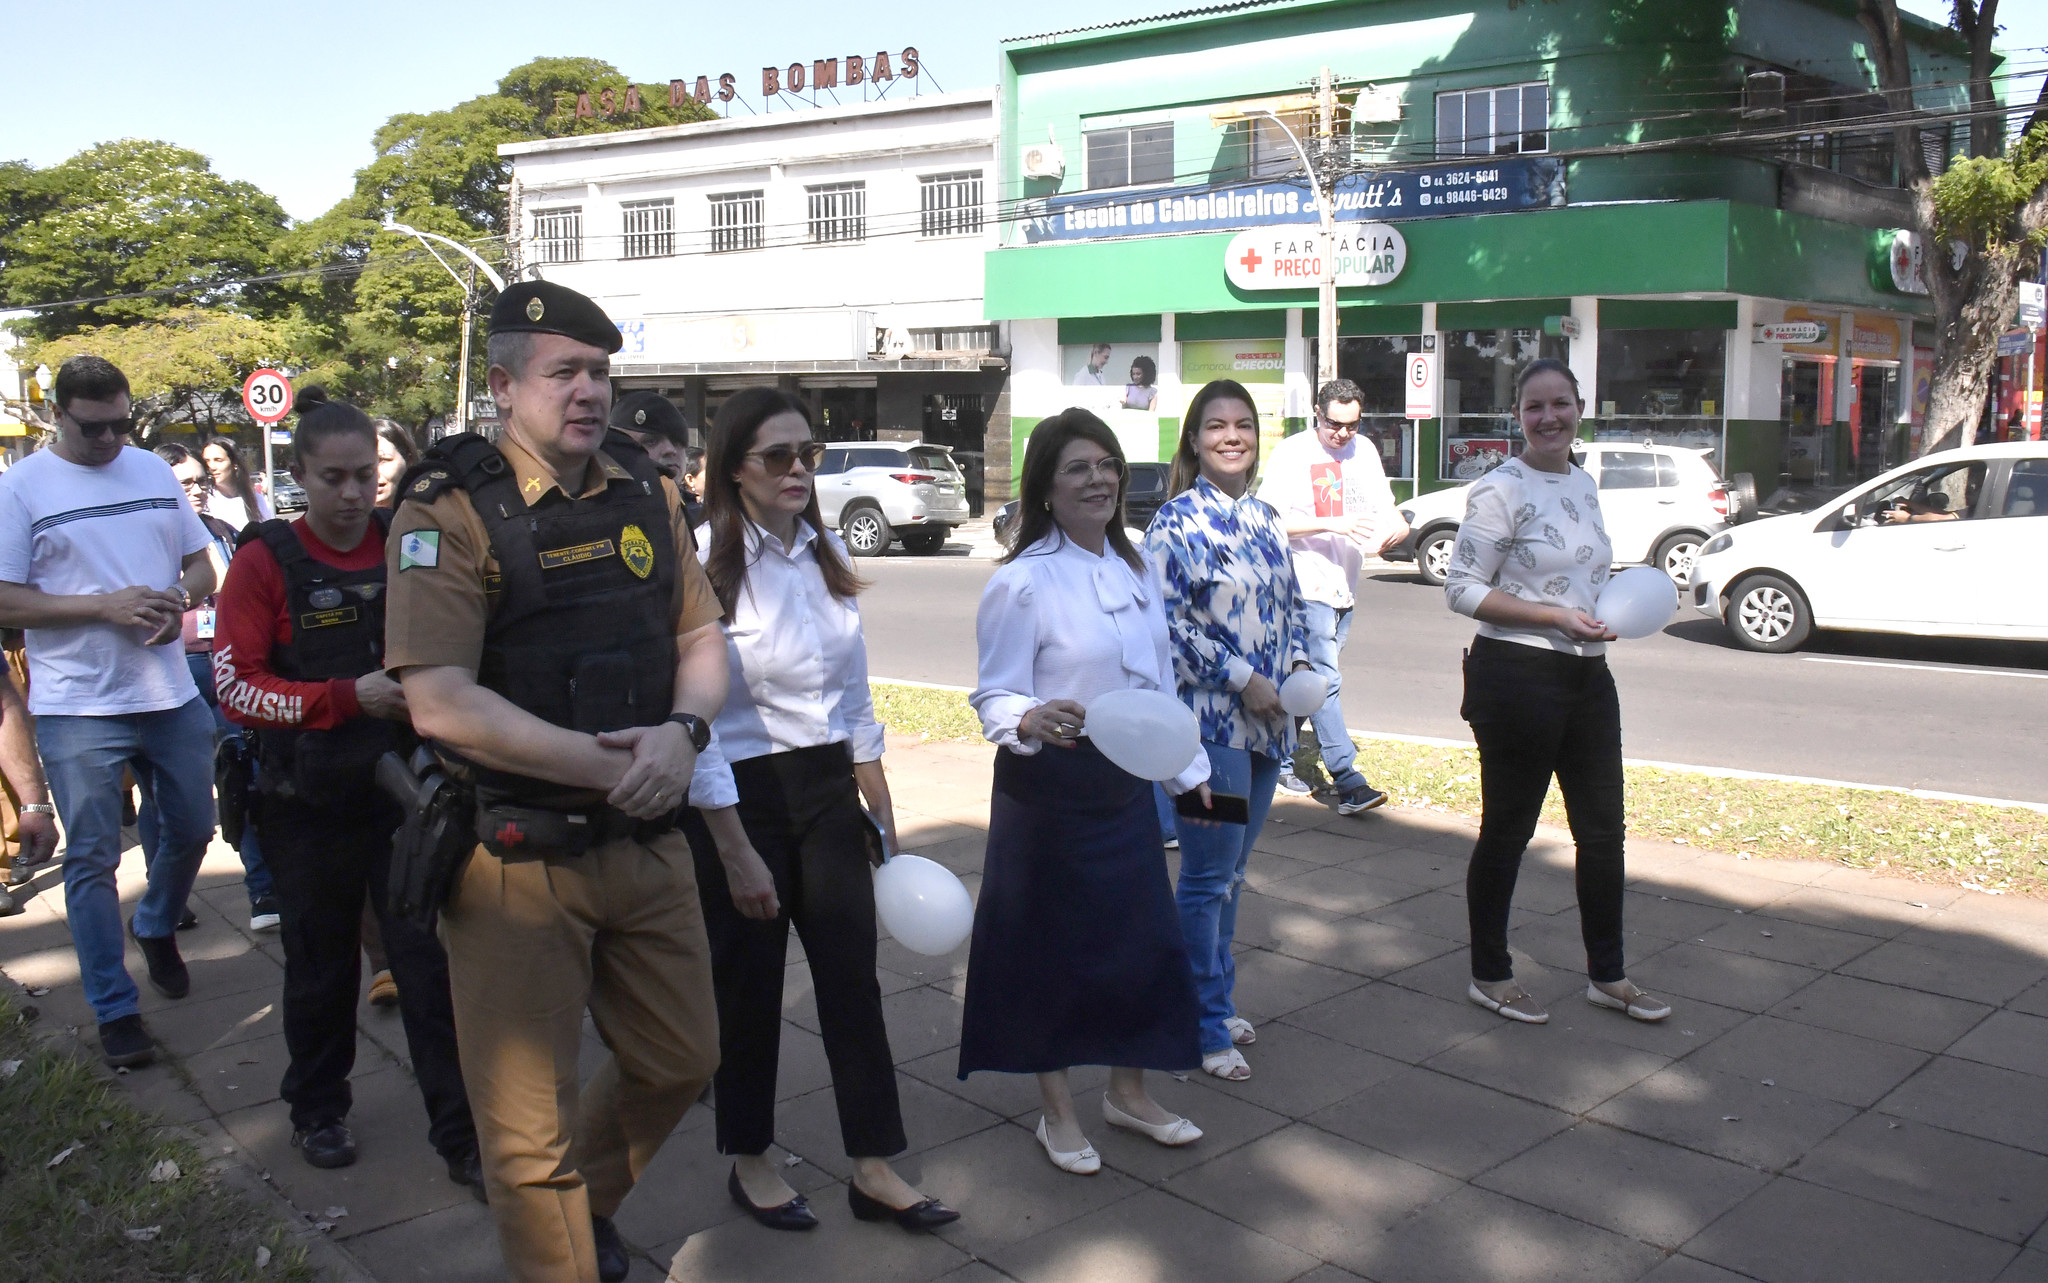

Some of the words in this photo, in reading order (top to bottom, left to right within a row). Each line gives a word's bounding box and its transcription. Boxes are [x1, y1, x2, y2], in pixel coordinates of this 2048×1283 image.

[669, 73, 736, 108] DAS
[762, 47, 919, 97] BOMBAS
[1446, 169, 1499, 186] 3624-5641
[1446, 187, 1508, 204] 98446-6429
[1064, 202, 1127, 231] Escola
[1130, 199, 1155, 226] de
[1158, 189, 1299, 224] Cabeleireiros
[1274, 235, 1395, 255] FARÁCIA
[1416, 364, 1422, 381] E
[252, 384, 283, 405] 30
